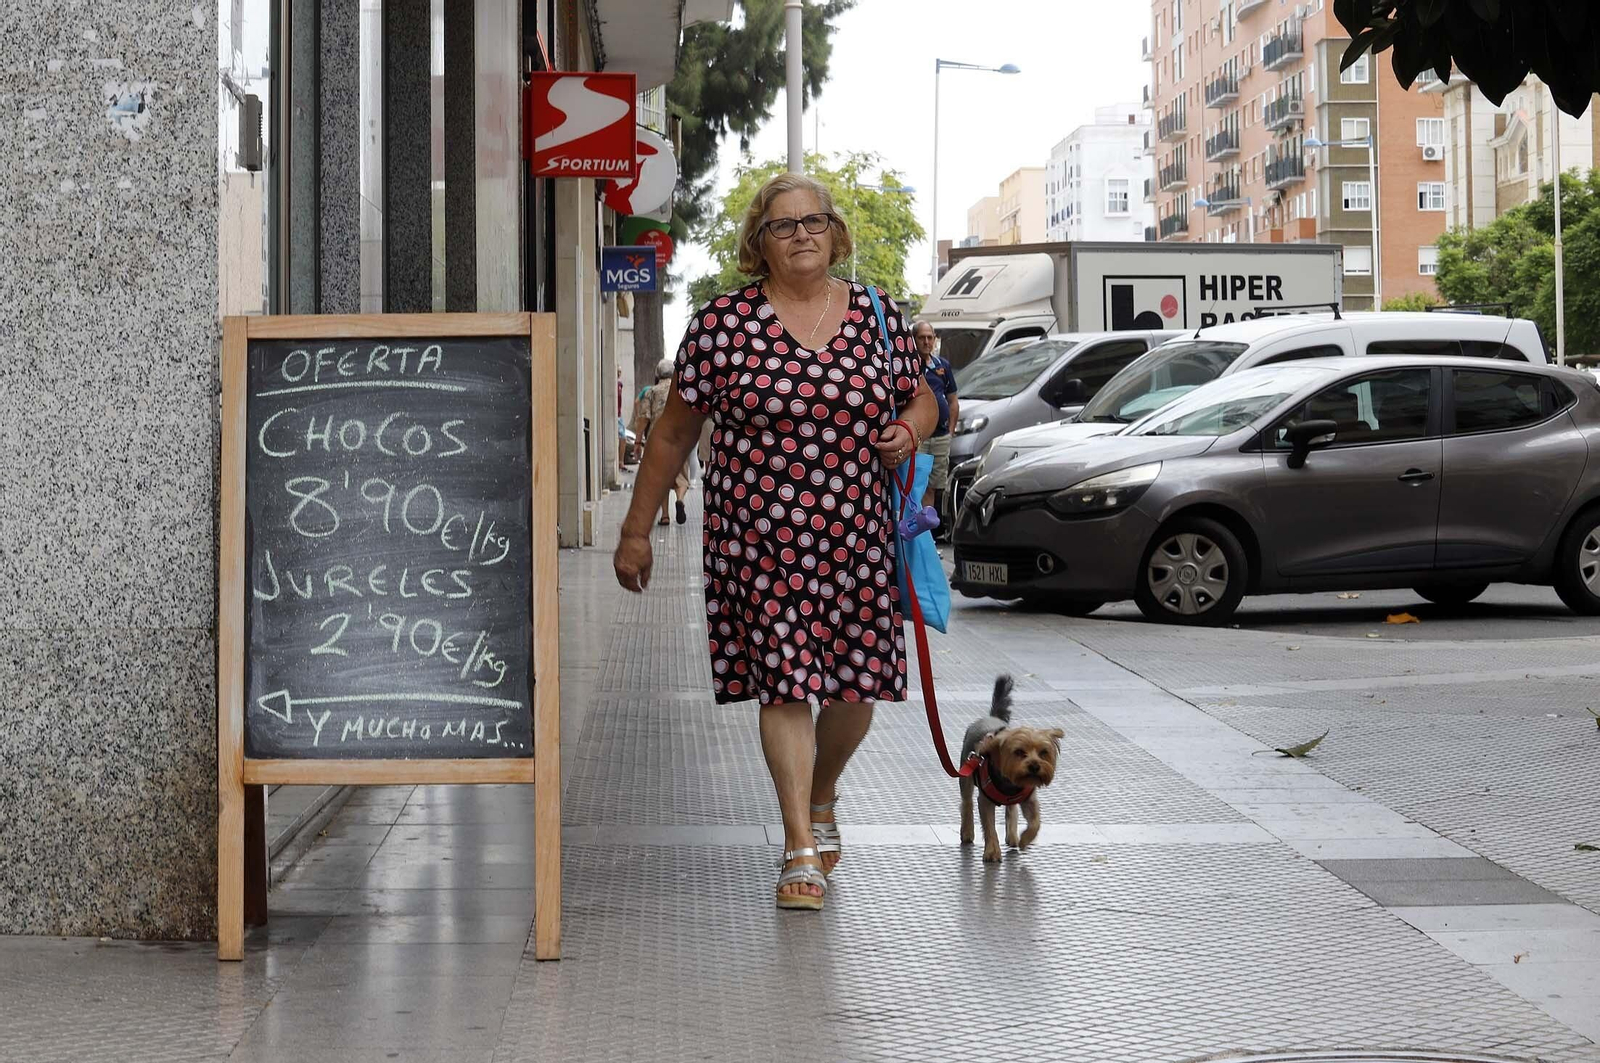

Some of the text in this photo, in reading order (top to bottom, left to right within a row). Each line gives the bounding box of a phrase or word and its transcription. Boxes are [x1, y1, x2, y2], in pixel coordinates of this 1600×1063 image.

[537, 155, 630, 173] SPORTIUM
[606, 268, 651, 284] MGS
[1199, 275, 1284, 301] HIPER
[281, 345, 443, 382] OFERTA
[258, 407, 468, 457] CHOCOS
[253, 551, 473, 600] JURELES
[969, 564, 1006, 583] 1521 HXL
[306, 709, 332, 746] Y
